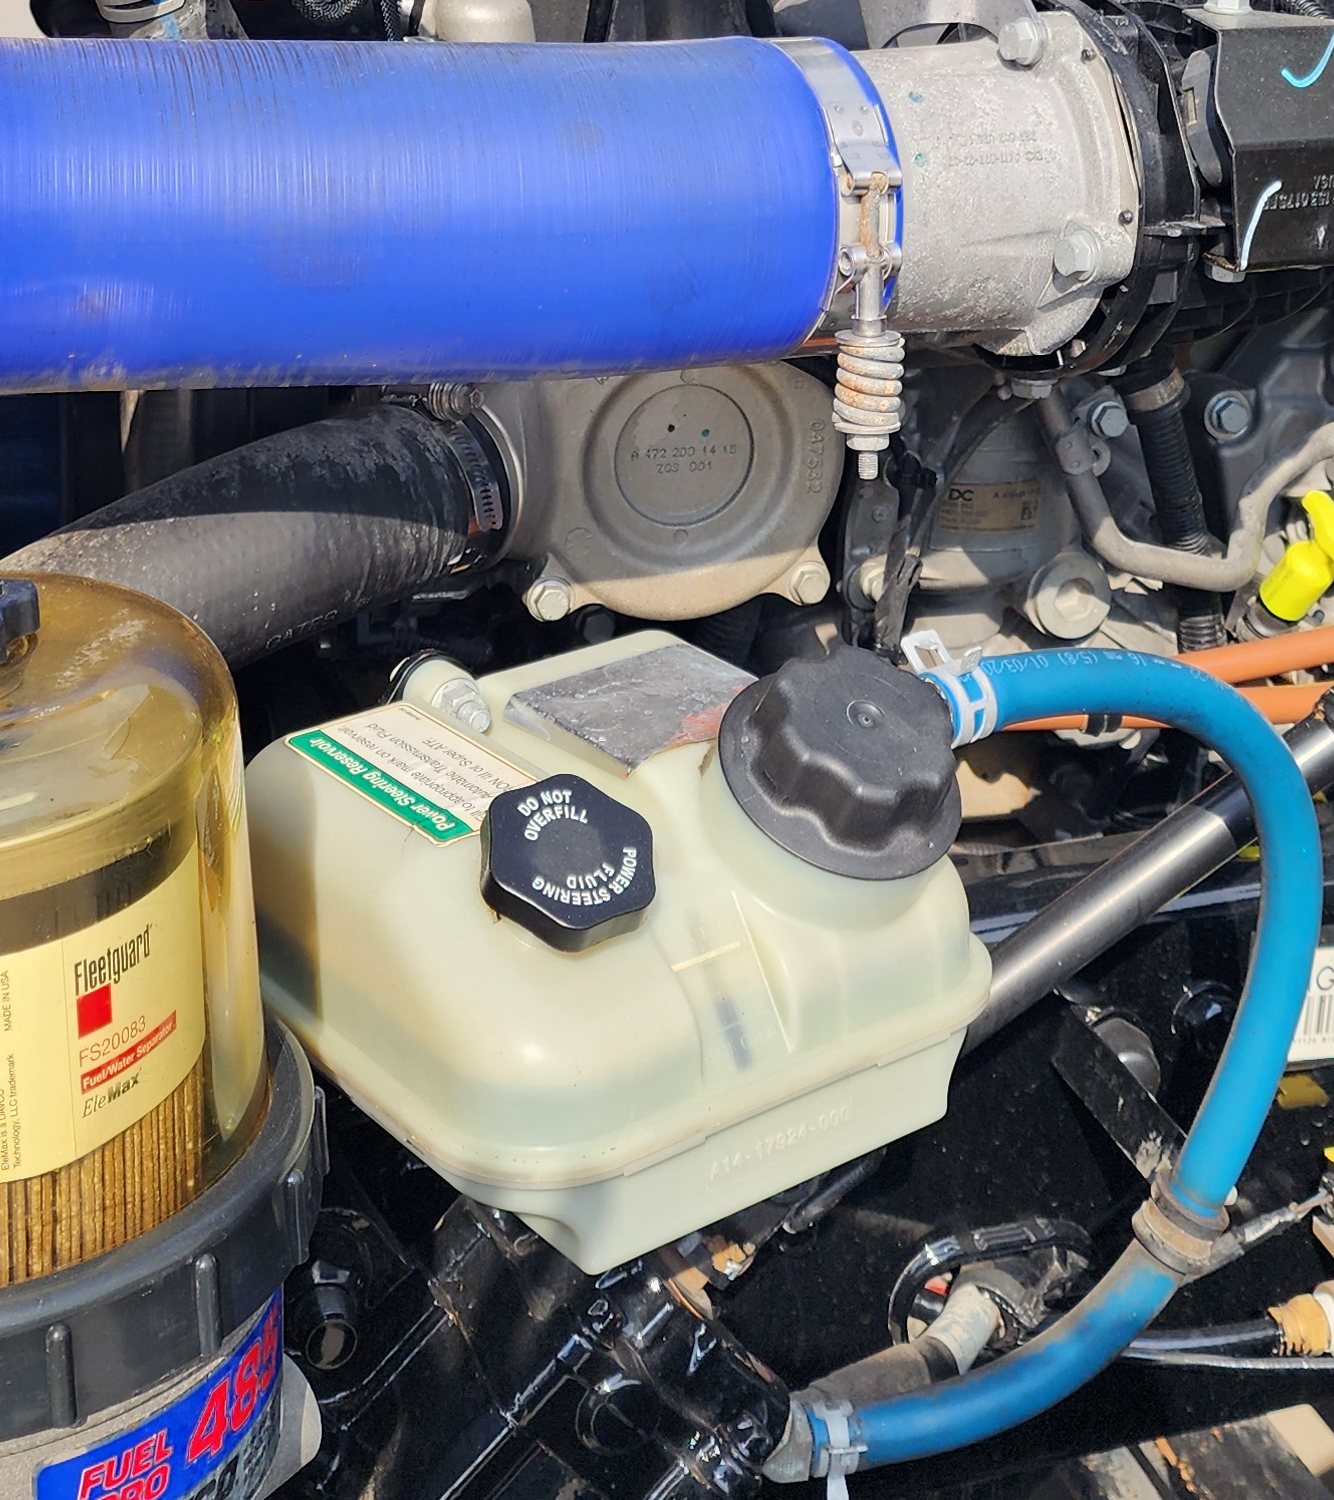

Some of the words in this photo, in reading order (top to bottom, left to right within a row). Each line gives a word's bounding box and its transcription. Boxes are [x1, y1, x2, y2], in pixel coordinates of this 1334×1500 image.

[806, 420, 825, 494] 047532
[949, 489, 974, 501] DC
[1059, 651, 1099, 666] (5/8)
[338, 726, 376, 752] reservoir.
[367, 722, 393, 740] Fluid
[422, 736, 448, 755] ATF.
[309, 736, 368, 776] Reservoir
[375, 747, 390, 760] on
[388, 755, 411, 776] mark
[394, 737, 446, 772] Transmission
[443, 747, 473, 769] Super
[471, 761, 482, 772] or
[364, 767, 416, 807] Steering
[410, 770, 463, 807] appropriate
[447, 769, 496, 800] Automatic
[415, 801, 455, 832] Power
[461, 801, 473, 813] to
[517, 796, 540, 817] DO
[540, 789, 572, 805] NOT
[524, 805, 589, 841] OVERFILL
[567, 862, 616, 889] FLUID
[609, 846, 637, 895] POWER
[531, 876, 611, 906] STEERING
[74, 923, 152, 997] Fleetguard
[0, 970, 10, 993] USA
[2, 994, 10, 1005] IN
[3, 1006, 12, 1032] MADE
[78, 1015, 146, 1068] FS20083
[82, 1052, 136, 1091] Fuel/Water
[136, 1019, 175, 1058] Separator
[8, 1054, 17, 1099] trademark
[10, 1100, 18, 1116] LLC
[81, 1070, 141, 1119] EleMax
[0, 1128, 8, 1136] is
[12, 1118, 21, 1169] Technology,
[0, 1137, 10, 1171] EleMax
[78, 1429, 174, 1500] FUEL
